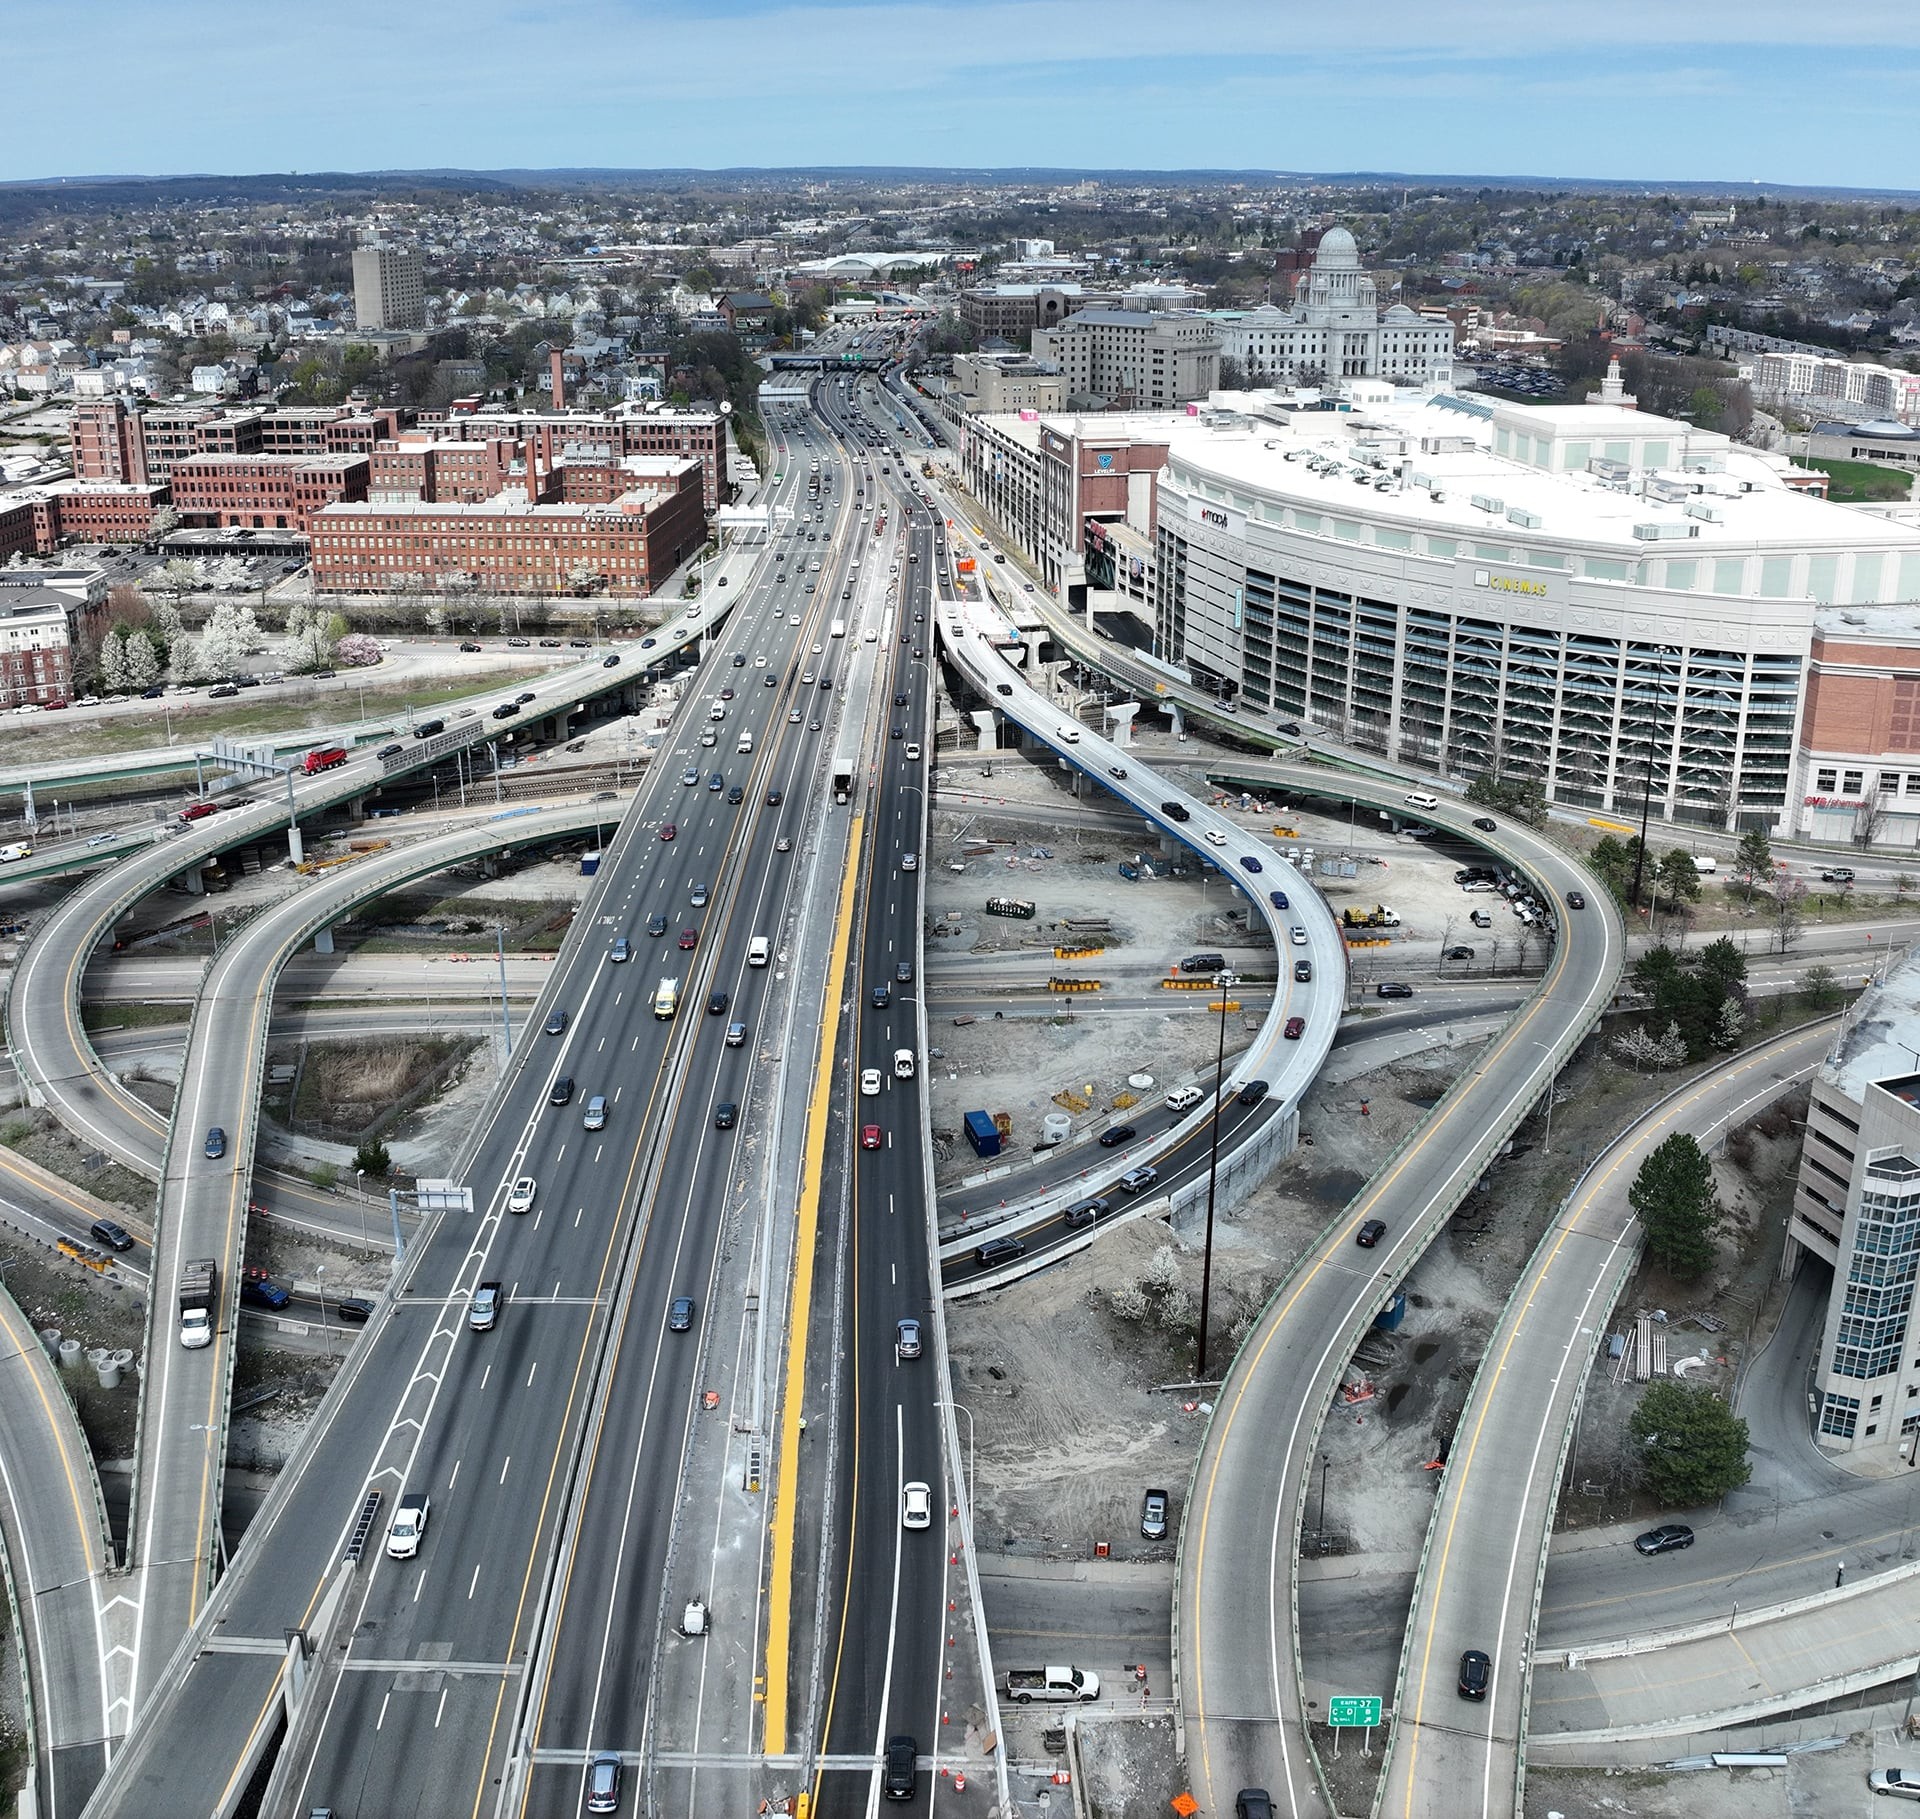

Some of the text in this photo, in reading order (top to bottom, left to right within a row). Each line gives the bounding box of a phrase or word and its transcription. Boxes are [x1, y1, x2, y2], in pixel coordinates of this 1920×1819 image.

[1491, 576, 1546, 597] CINEMAS
[1359, 1699, 1372, 1708] 37
[1332, 1708, 1339, 1716] C
